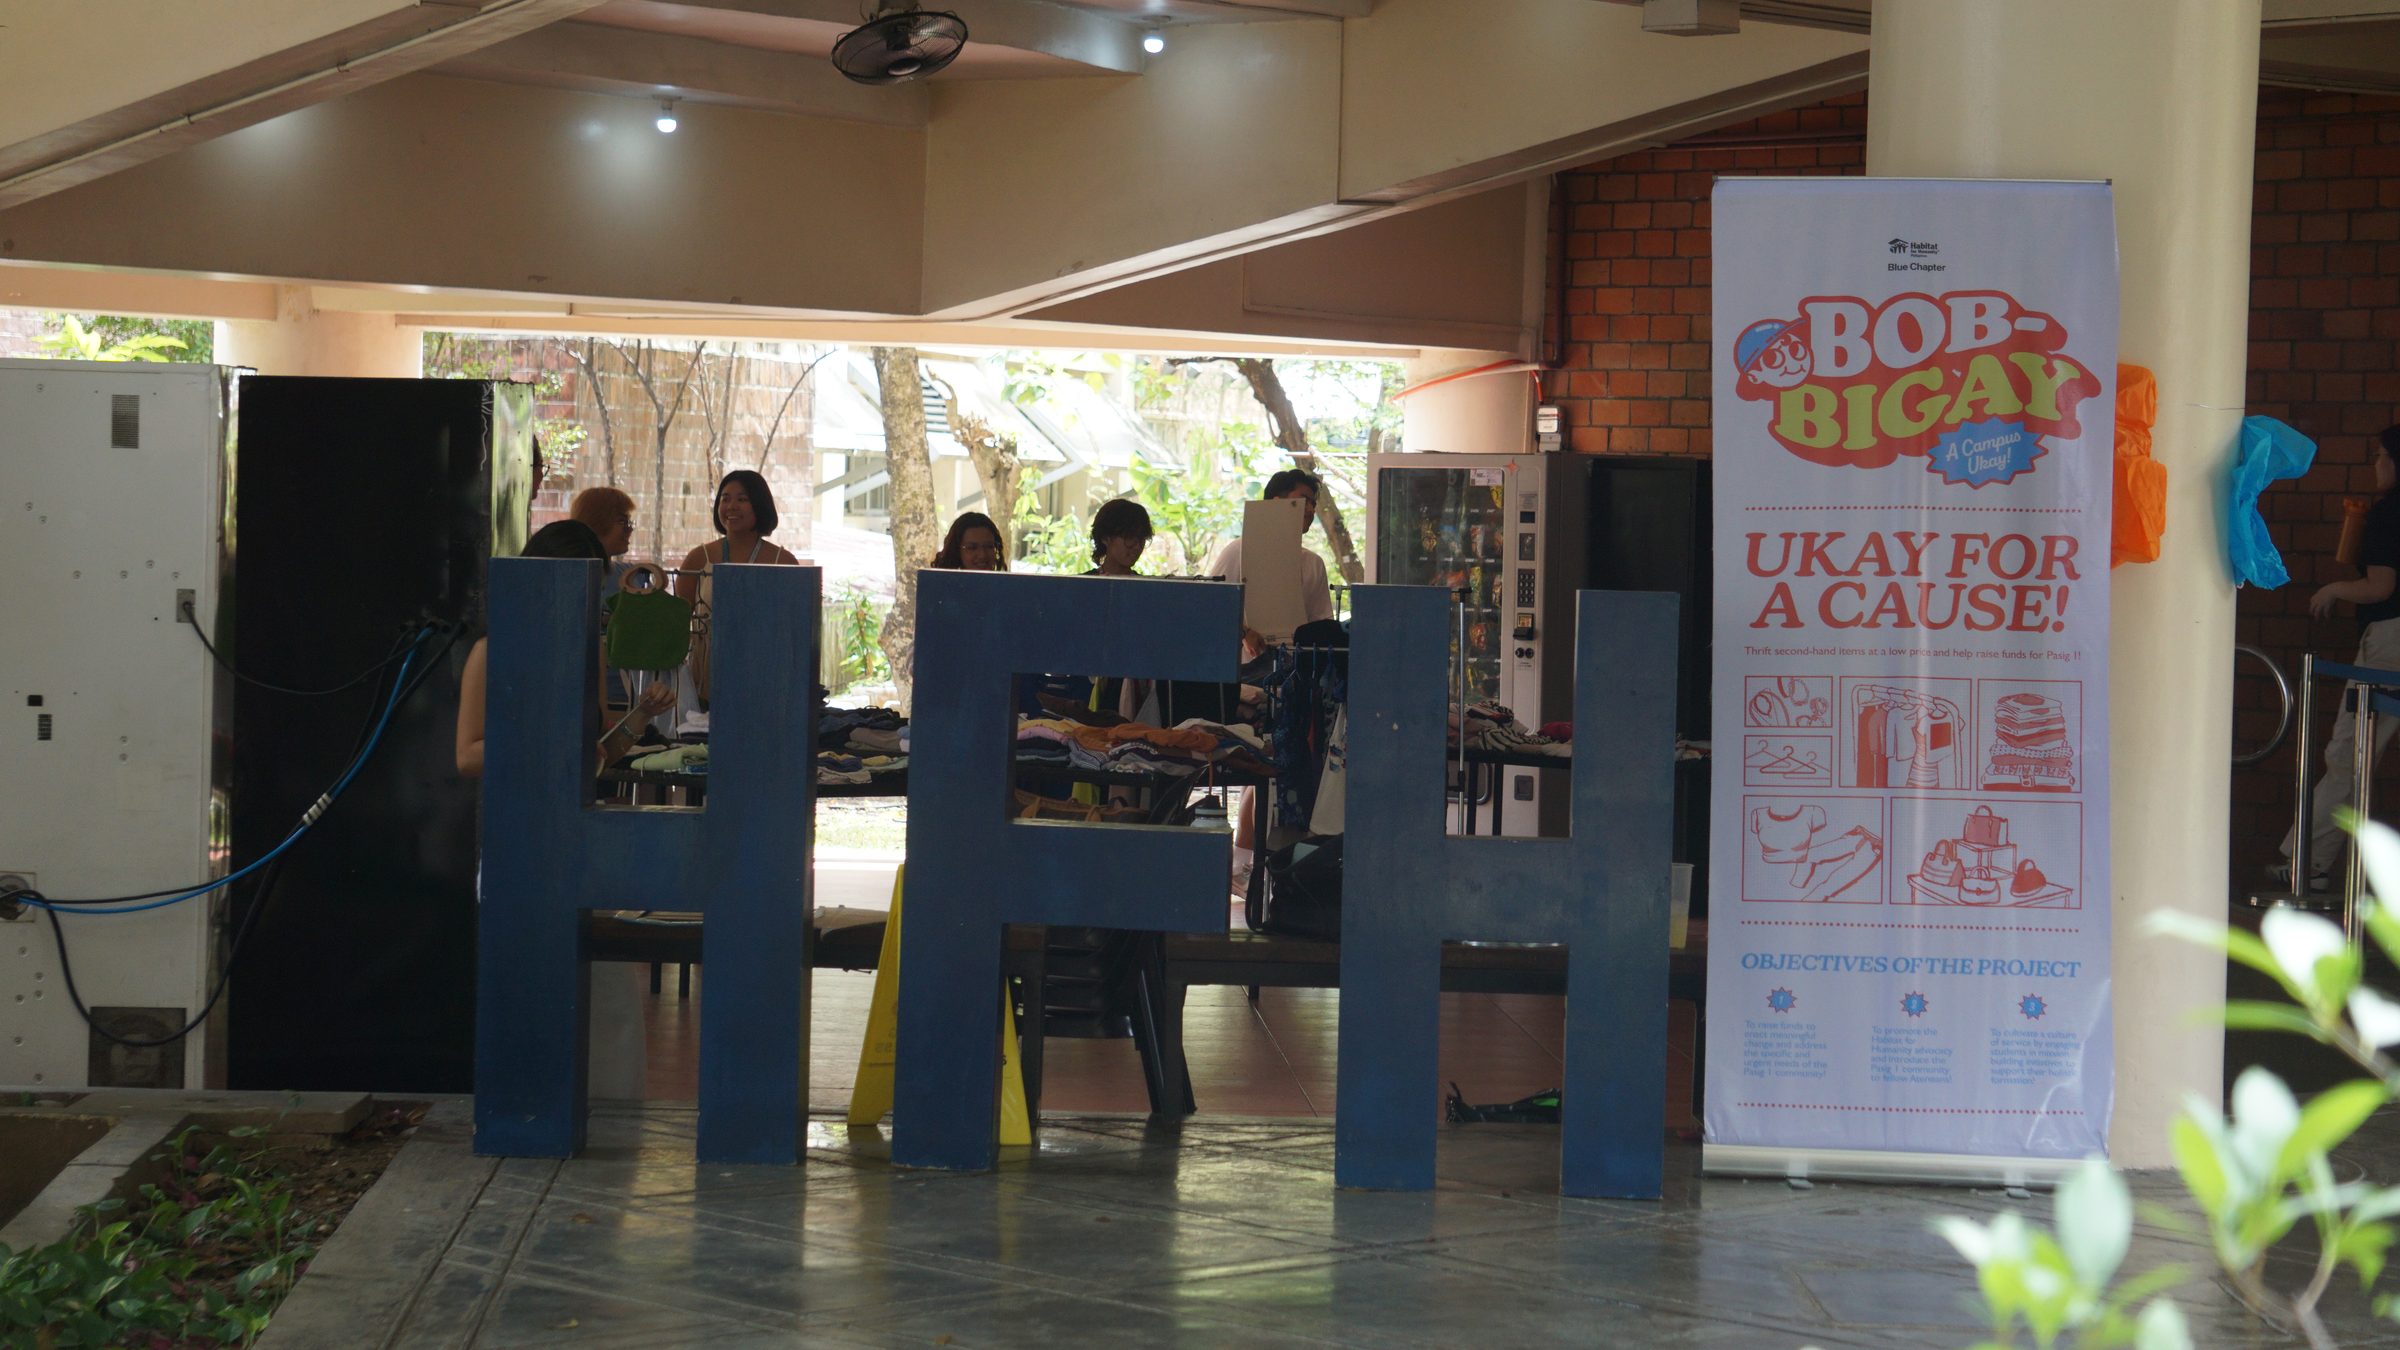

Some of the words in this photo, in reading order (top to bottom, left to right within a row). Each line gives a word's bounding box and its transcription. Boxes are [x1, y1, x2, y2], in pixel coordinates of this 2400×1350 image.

[1910, 242, 1938, 250] Habitat
[1888, 263, 1908, 271] Blue
[1910, 262, 1946, 272] Chapter
[1805, 296, 2047, 378] BOB-
[1774, 352, 2081, 451] BIGAY
[1945, 442, 1959, 462] A
[1962, 432, 2021, 457] Campus
[1968, 447, 2012, 475] Ukay!
[1745, 531, 1940, 578] UKAY
[1944, 532, 2082, 581] FOR
[1749, 581, 1805, 629] A
[1818, 581, 2070, 633] CAUSE!
[1744, 646, 1771, 656] Thrift
[1775, 646, 1836, 656] second-hand
[1839, 647, 1865, 656] items
[1889, 647, 1906, 656] low
[1909, 648, 1931, 658] price
[1933, 648, 1950, 657] and
[1953, 649, 1973, 659] help
[1976, 650, 1999, 658] raise
[2002, 650, 2027, 659] funds
[2030, 650, 2042, 660] for
[2046, 651, 2070, 662] Pasig
[1740, 952, 1888, 973] OBJECTIVES
[1892, 957, 1925, 974] OF
[1925, 957, 1973, 975] THE
[1976, 959, 2082, 977] PROJECT
[2028, 1002, 2036, 1012] 3
